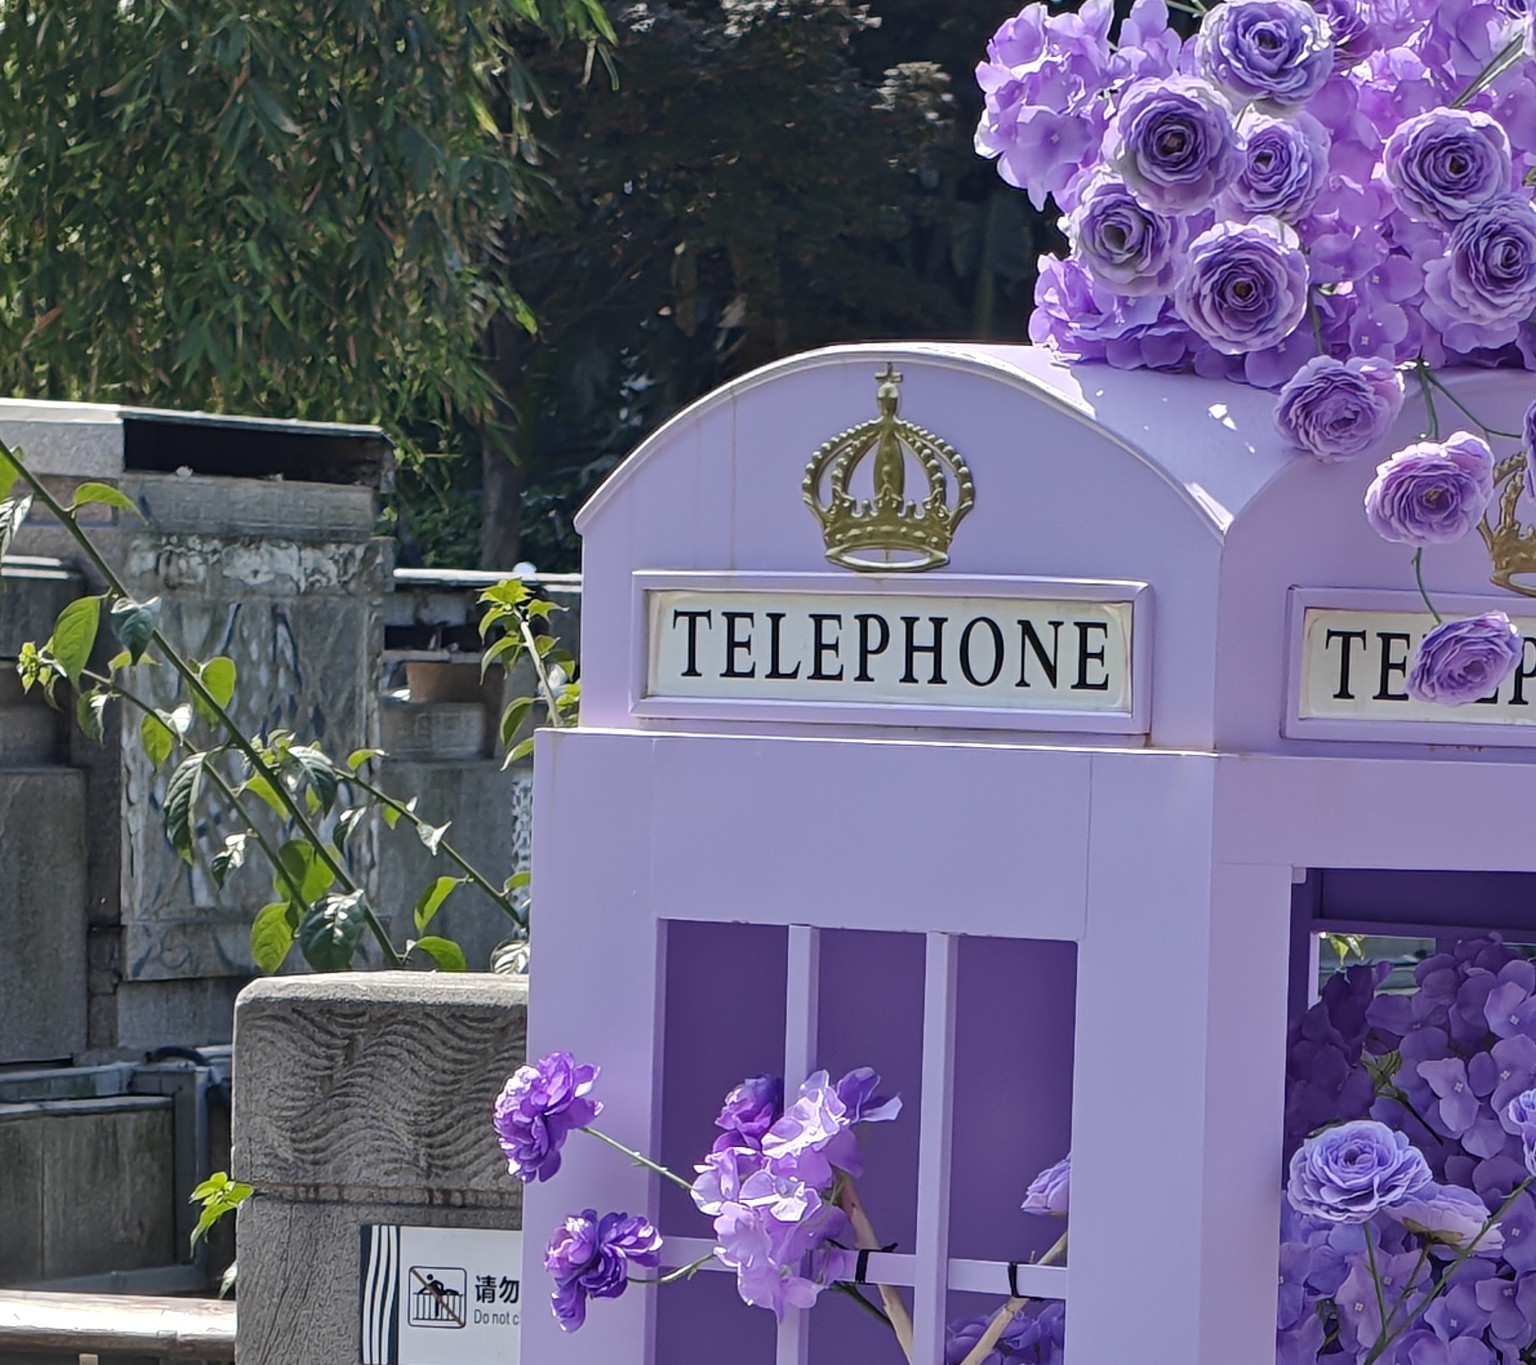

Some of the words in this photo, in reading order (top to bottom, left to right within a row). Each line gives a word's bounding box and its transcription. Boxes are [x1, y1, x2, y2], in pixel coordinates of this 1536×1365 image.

[672, 608, 1110, 691] TELEPHONE
[474, 1274, 520, 1304] 请勿
[473, 1308, 490, 1325] Do
[491, 1311, 510, 1325] not
